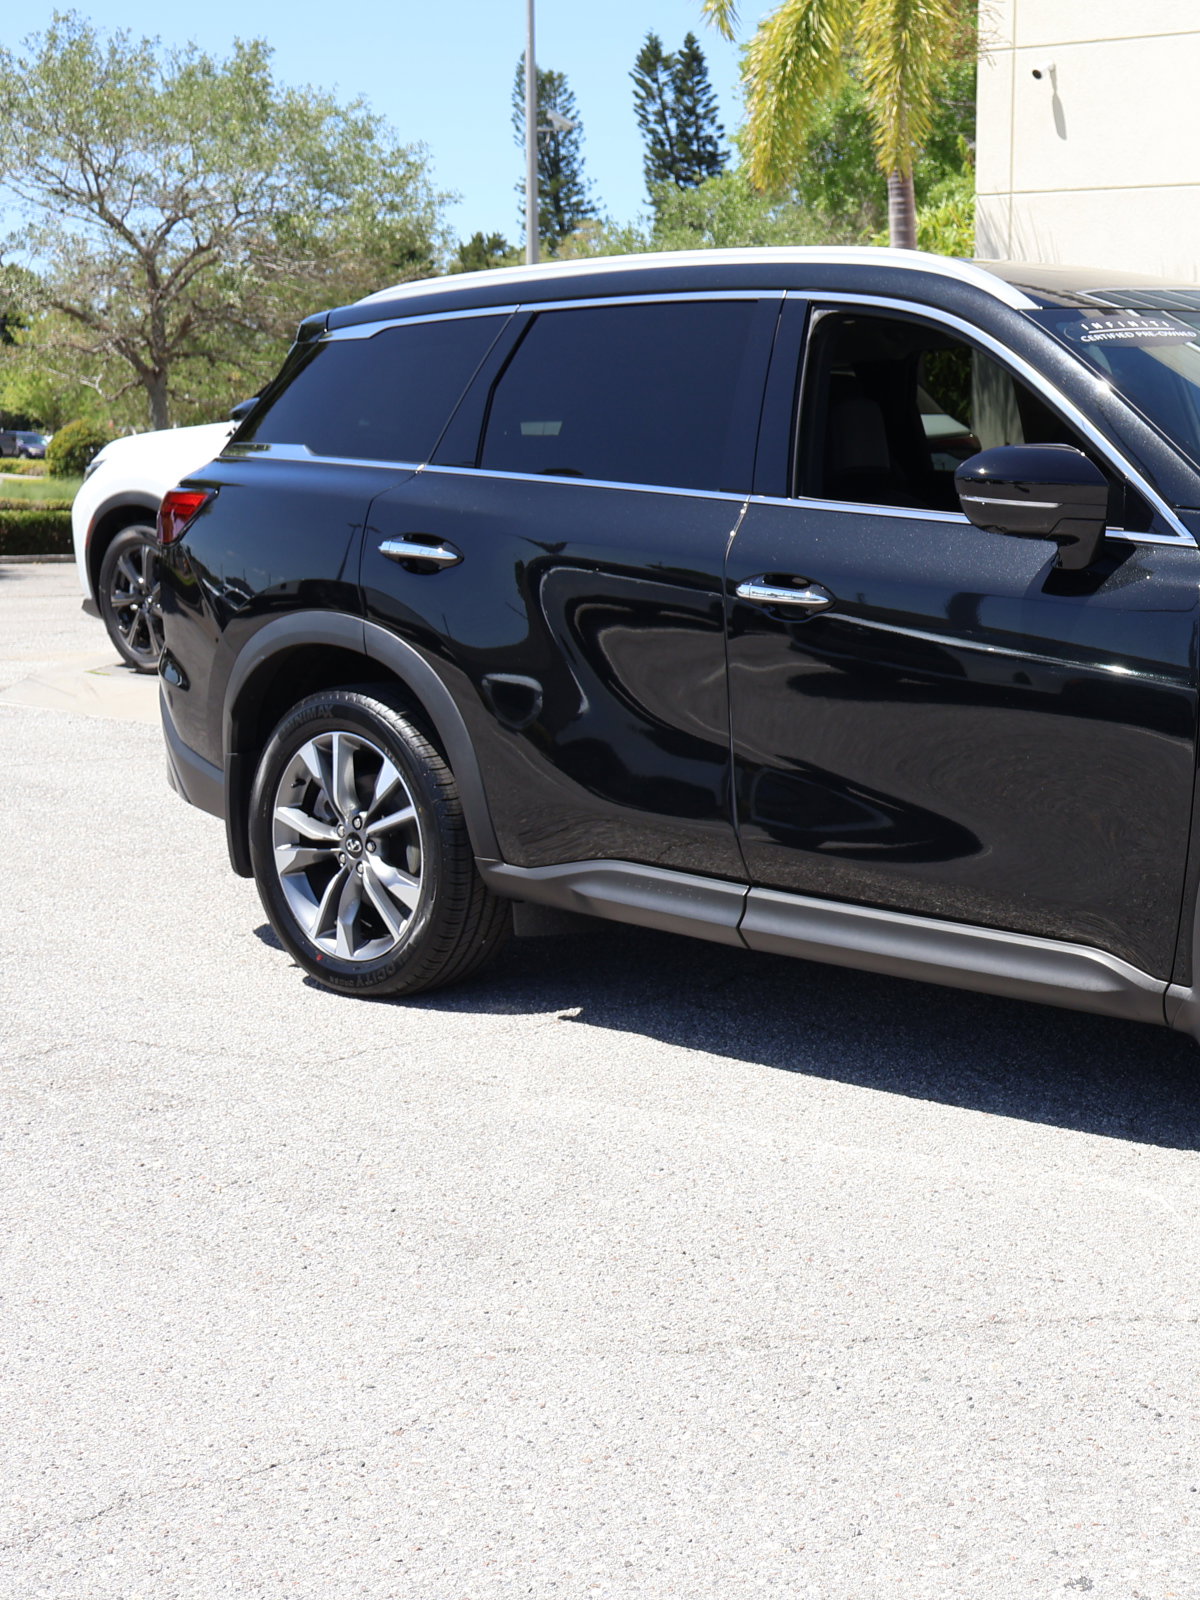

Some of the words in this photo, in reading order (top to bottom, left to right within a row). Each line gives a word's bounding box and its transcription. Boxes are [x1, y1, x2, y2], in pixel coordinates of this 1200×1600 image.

[1080, 320, 1170, 331] INFINITI
[1080, 331, 1135, 343] CERTIFIED
[1136, 330, 1198, 339] PRE-OWNED
